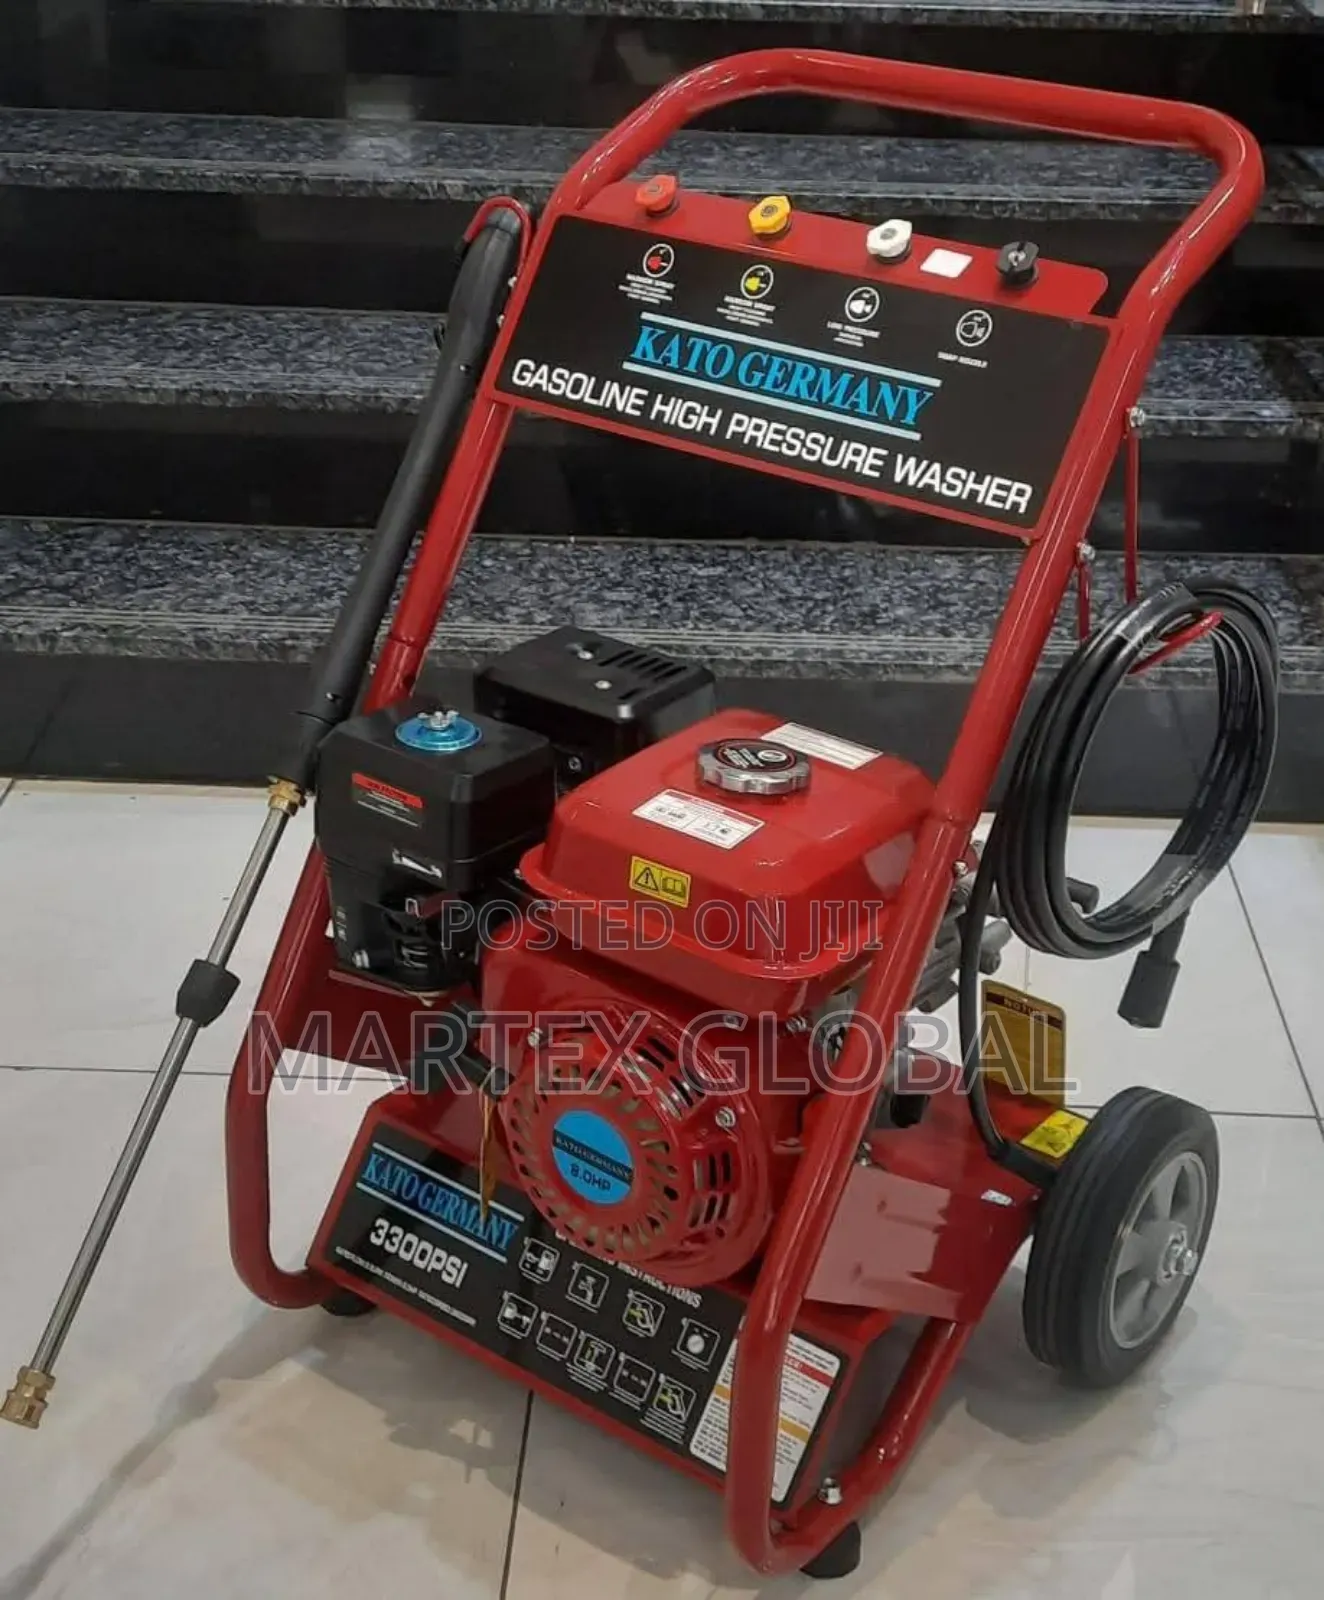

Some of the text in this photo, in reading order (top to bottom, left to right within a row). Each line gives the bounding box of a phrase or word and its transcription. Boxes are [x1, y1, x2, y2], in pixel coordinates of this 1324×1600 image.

[630, 325, 934, 425] KATO GERMANY
[512, 359, 1033, 514] GASOLINE HIGH PRESSURE WASHER
[370, 1217, 469, 1289] 3300PSI
